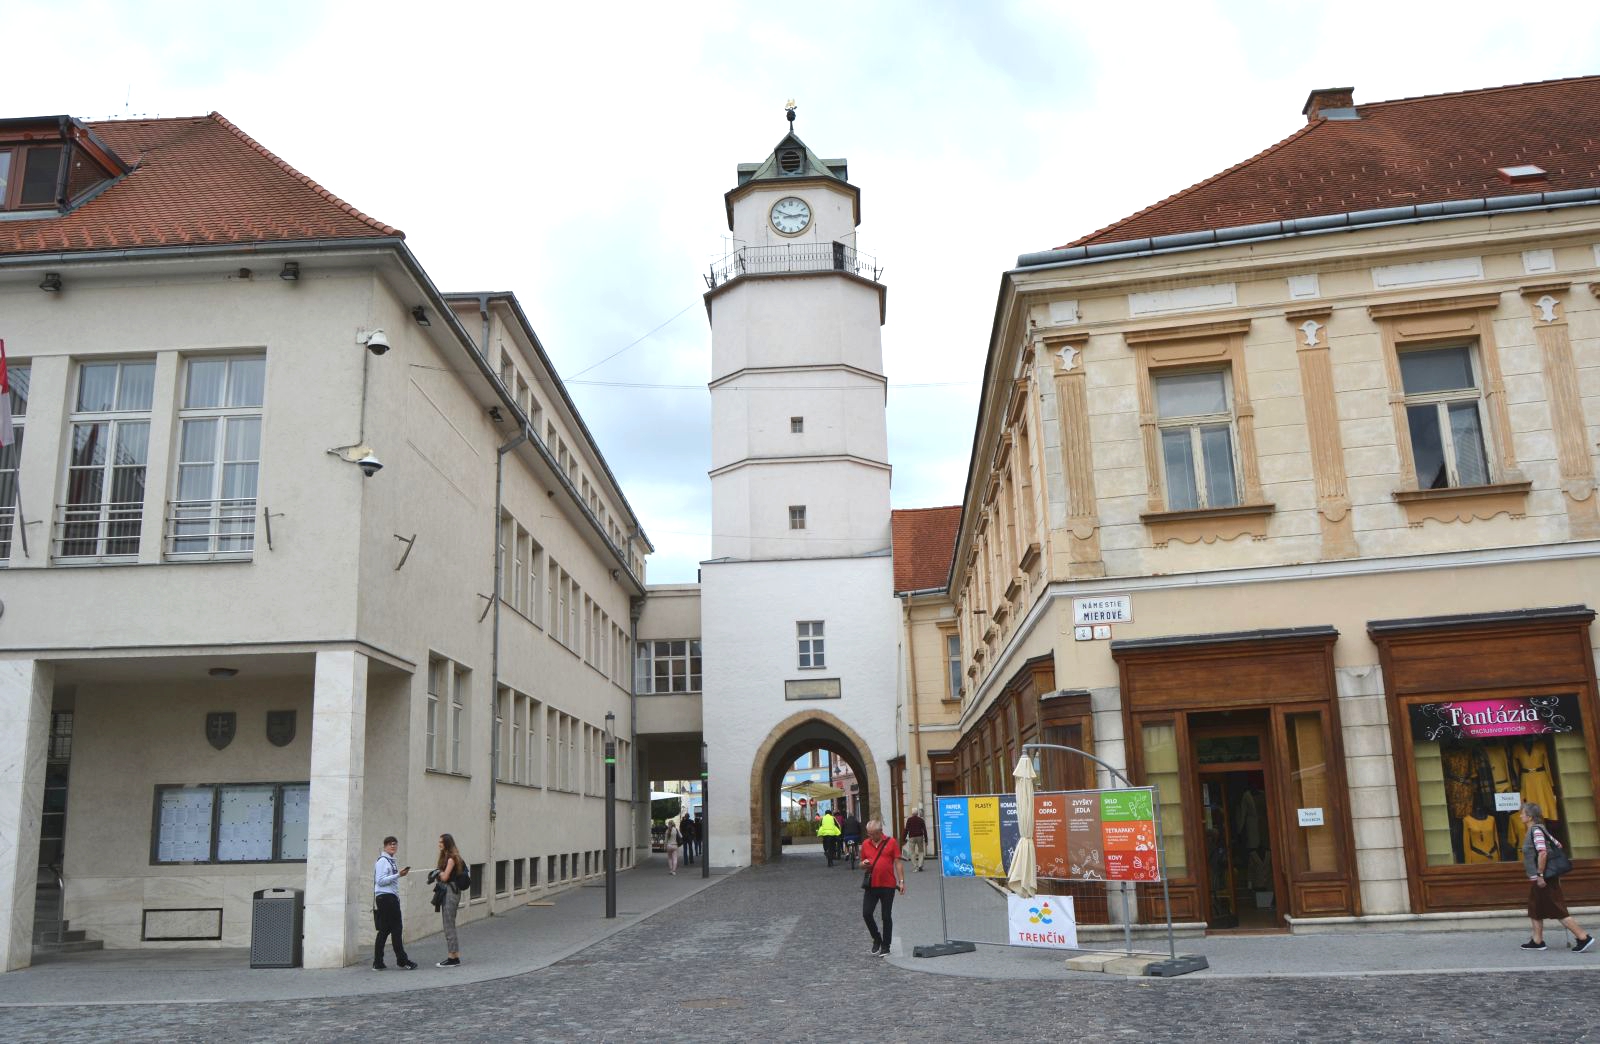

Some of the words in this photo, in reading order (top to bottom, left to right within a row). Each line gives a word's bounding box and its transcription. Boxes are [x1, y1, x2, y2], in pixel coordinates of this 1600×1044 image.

[1082, 600, 1122, 609] NÁMESTIE
[1084, 609, 1122, 620] MIEROVÉ
[1450, 704, 1539, 727] Fantázia
[1019, 931, 1065, 944] TRENČÍN
